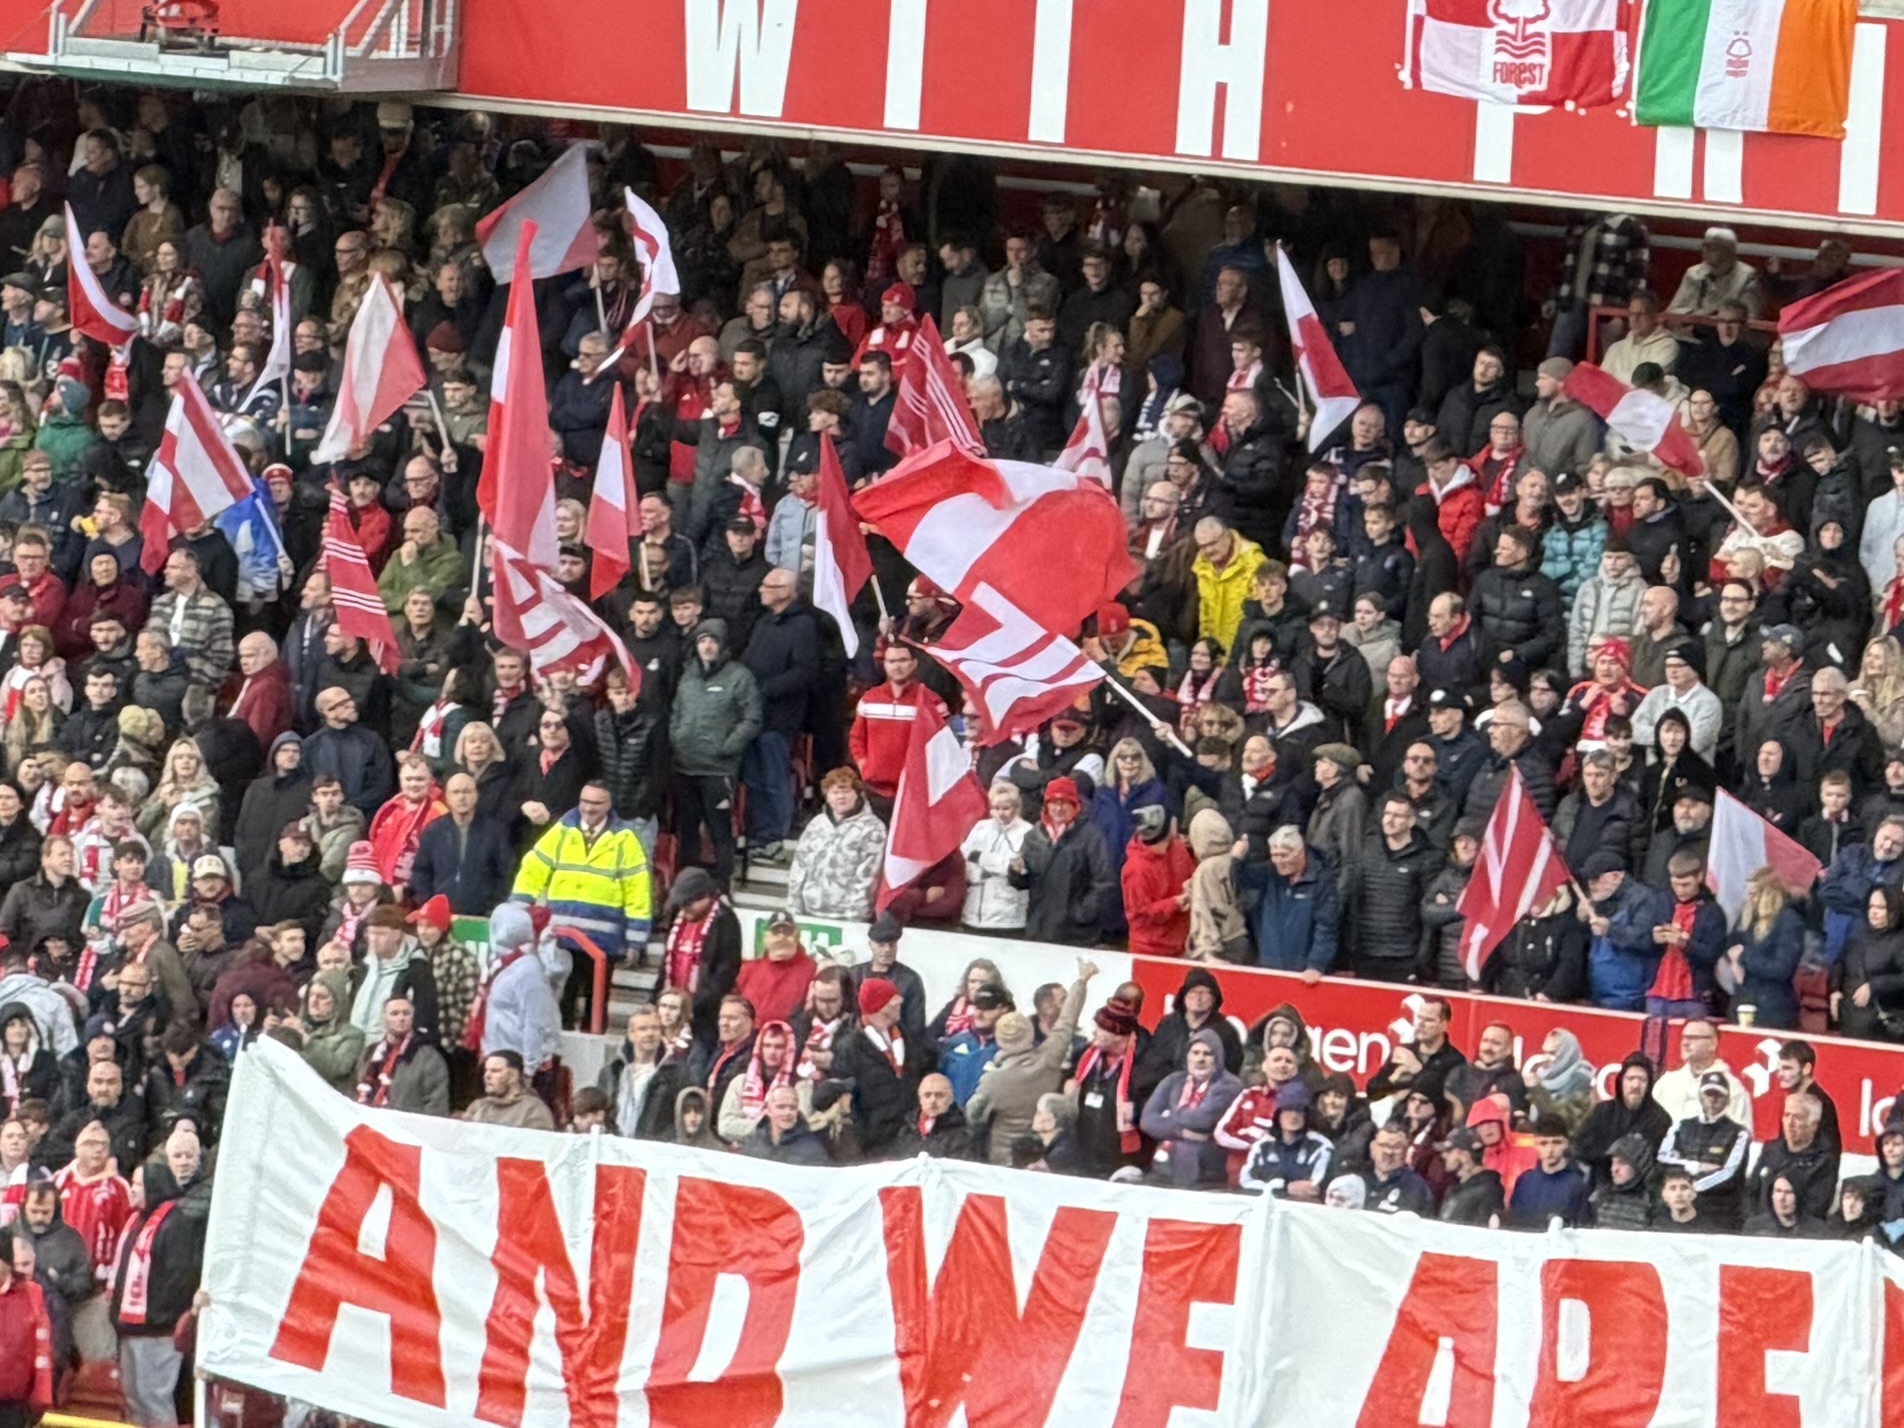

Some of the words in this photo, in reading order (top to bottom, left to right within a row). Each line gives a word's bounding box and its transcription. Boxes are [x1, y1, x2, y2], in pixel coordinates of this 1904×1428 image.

[1492, 58, 1546, 89] FOREST
[268, 1123, 805, 1428] AND
[877, 1184, 1244, 1428] WE
